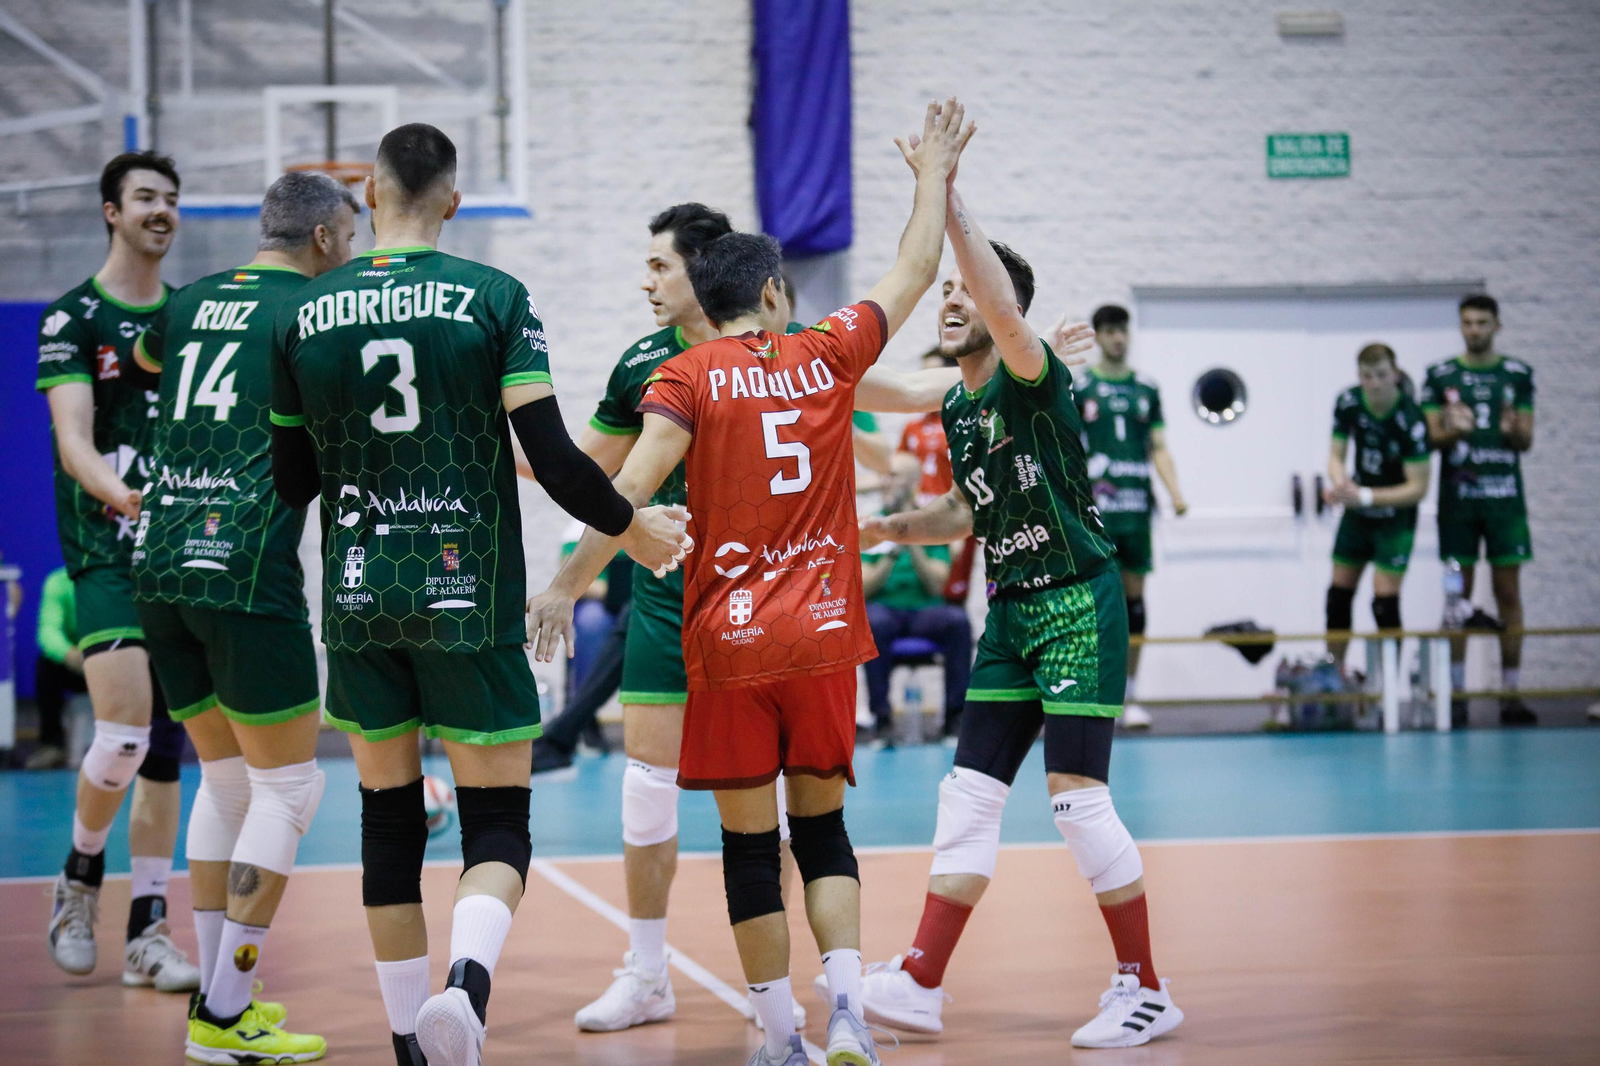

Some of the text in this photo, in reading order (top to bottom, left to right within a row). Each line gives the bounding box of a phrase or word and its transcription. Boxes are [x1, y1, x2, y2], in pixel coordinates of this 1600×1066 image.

[192, 300, 259, 331] RUIZ
[297, 278, 476, 340] RODRÍGUEZ
[624, 347, 669, 368] vellsam
[173, 341, 242, 421] 14
[360, 337, 421, 434] 3
[760, 409, 812, 496] 5
[157, 465, 241, 491] Andalucía
[366, 485, 469, 517] Andalucía
[755, 527, 838, 565] Andalcía
[425, 574, 476, 586] DIPUTACIÓN
[426, 584, 476, 595] DE ALMERÍA
[335, 592, 374, 604] ALMERÍA
[721, 626, 765, 641] ALMERÍA
[731, 637, 755, 646] CIUDAD
